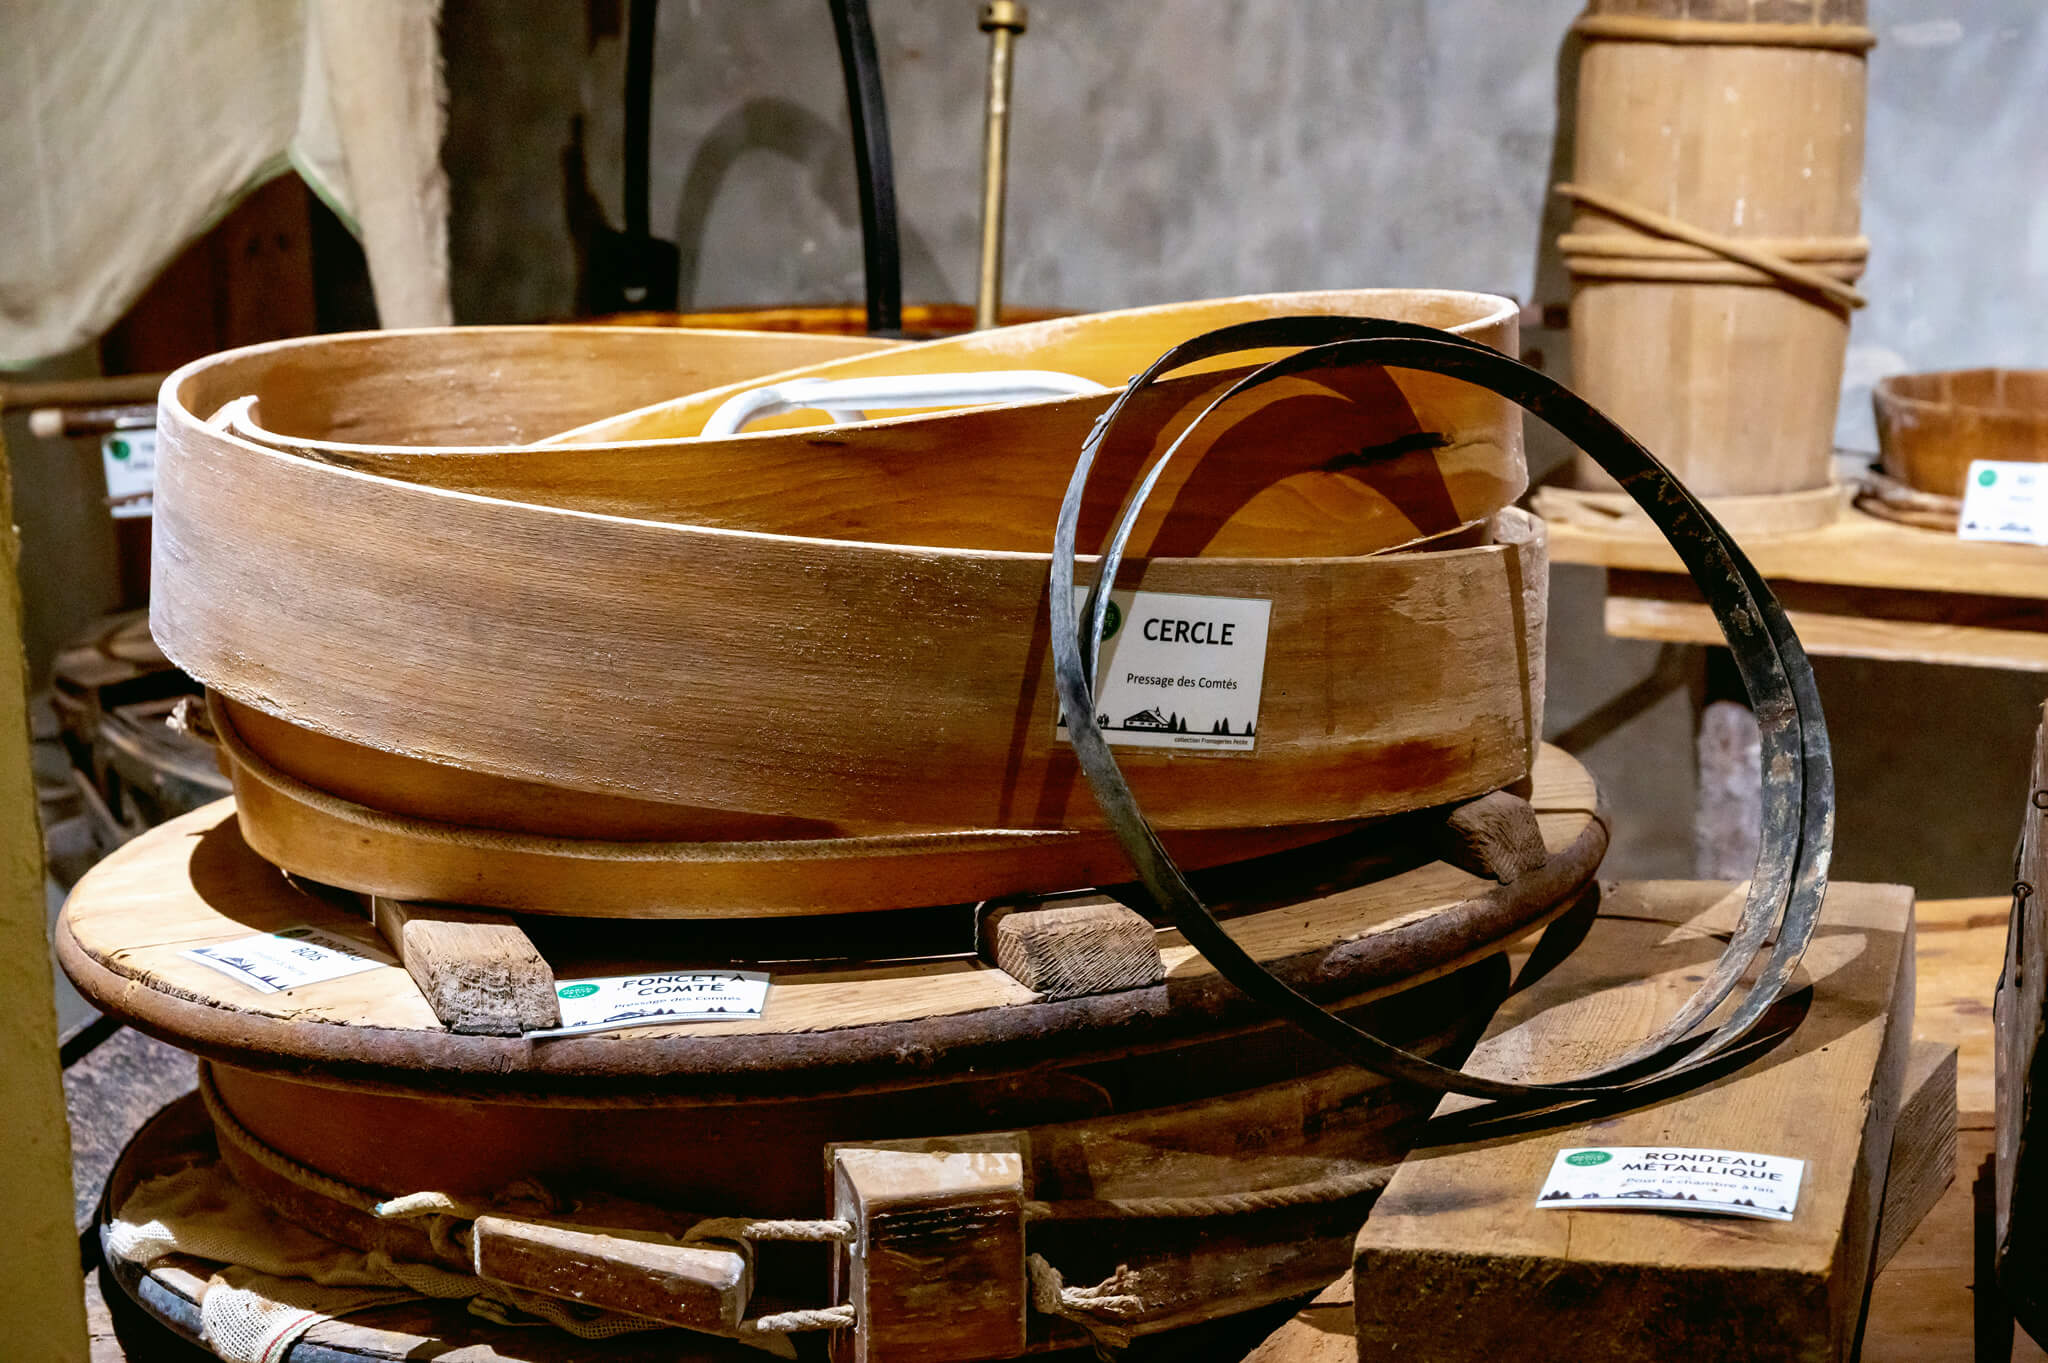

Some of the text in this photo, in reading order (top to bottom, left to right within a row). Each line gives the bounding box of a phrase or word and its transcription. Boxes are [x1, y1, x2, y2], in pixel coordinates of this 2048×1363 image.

[1143, 618, 1236, 646] CERCLE
[1126, 672, 1238, 690] Pressage des Comtés
[622, 974, 724, 989] FONCET
[637, 982, 726, 996] COMTÉ
[1644, 1152, 1768, 1168] RONDEAU
[1621, 1161, 1784, 1182] MÉTALLIQUE
